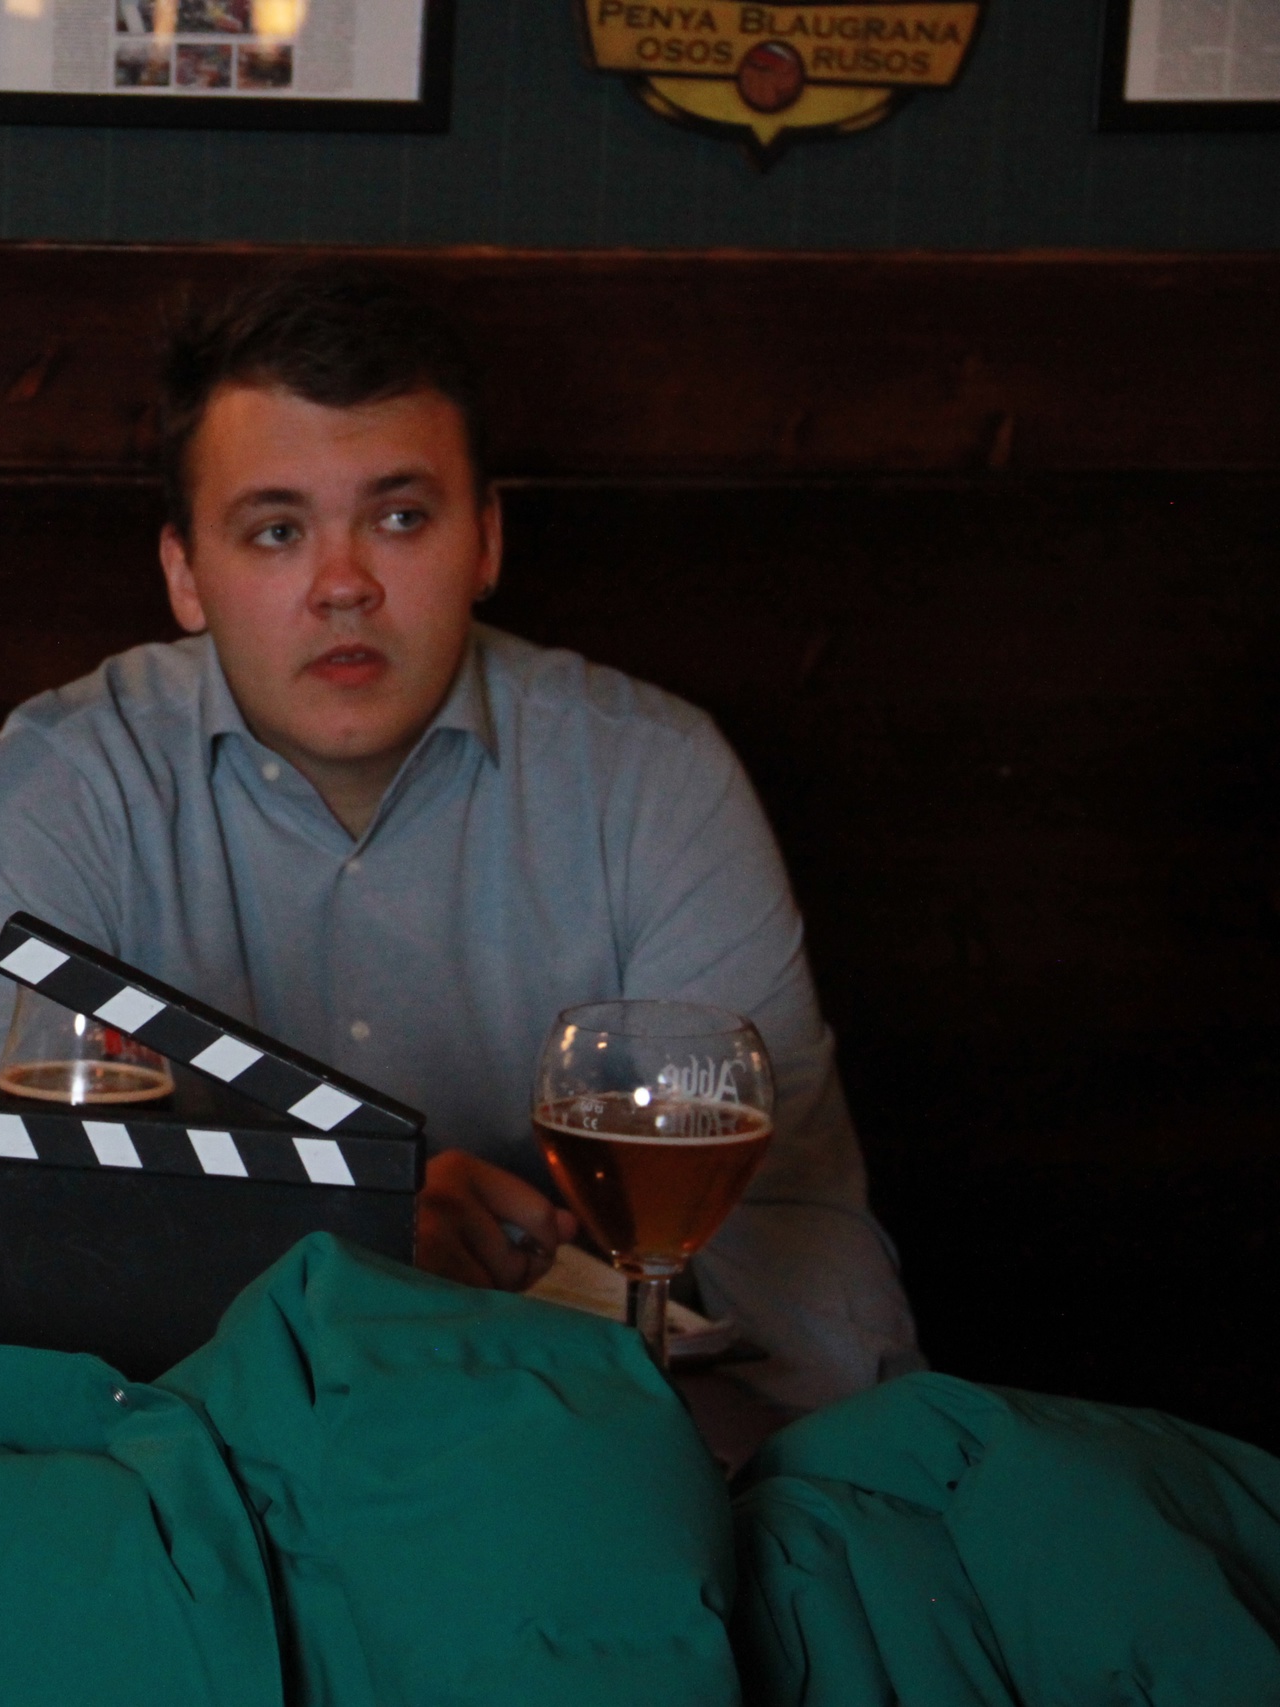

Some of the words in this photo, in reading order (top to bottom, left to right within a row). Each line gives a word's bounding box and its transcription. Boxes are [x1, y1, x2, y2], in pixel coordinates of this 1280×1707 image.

[598, 0, 717, 33] PENYA
[739, 6, 962, 44] BLAUGRANA
[636, 36, 733, 65] OSOS
[811, 46, 931, 76] RUSOS
